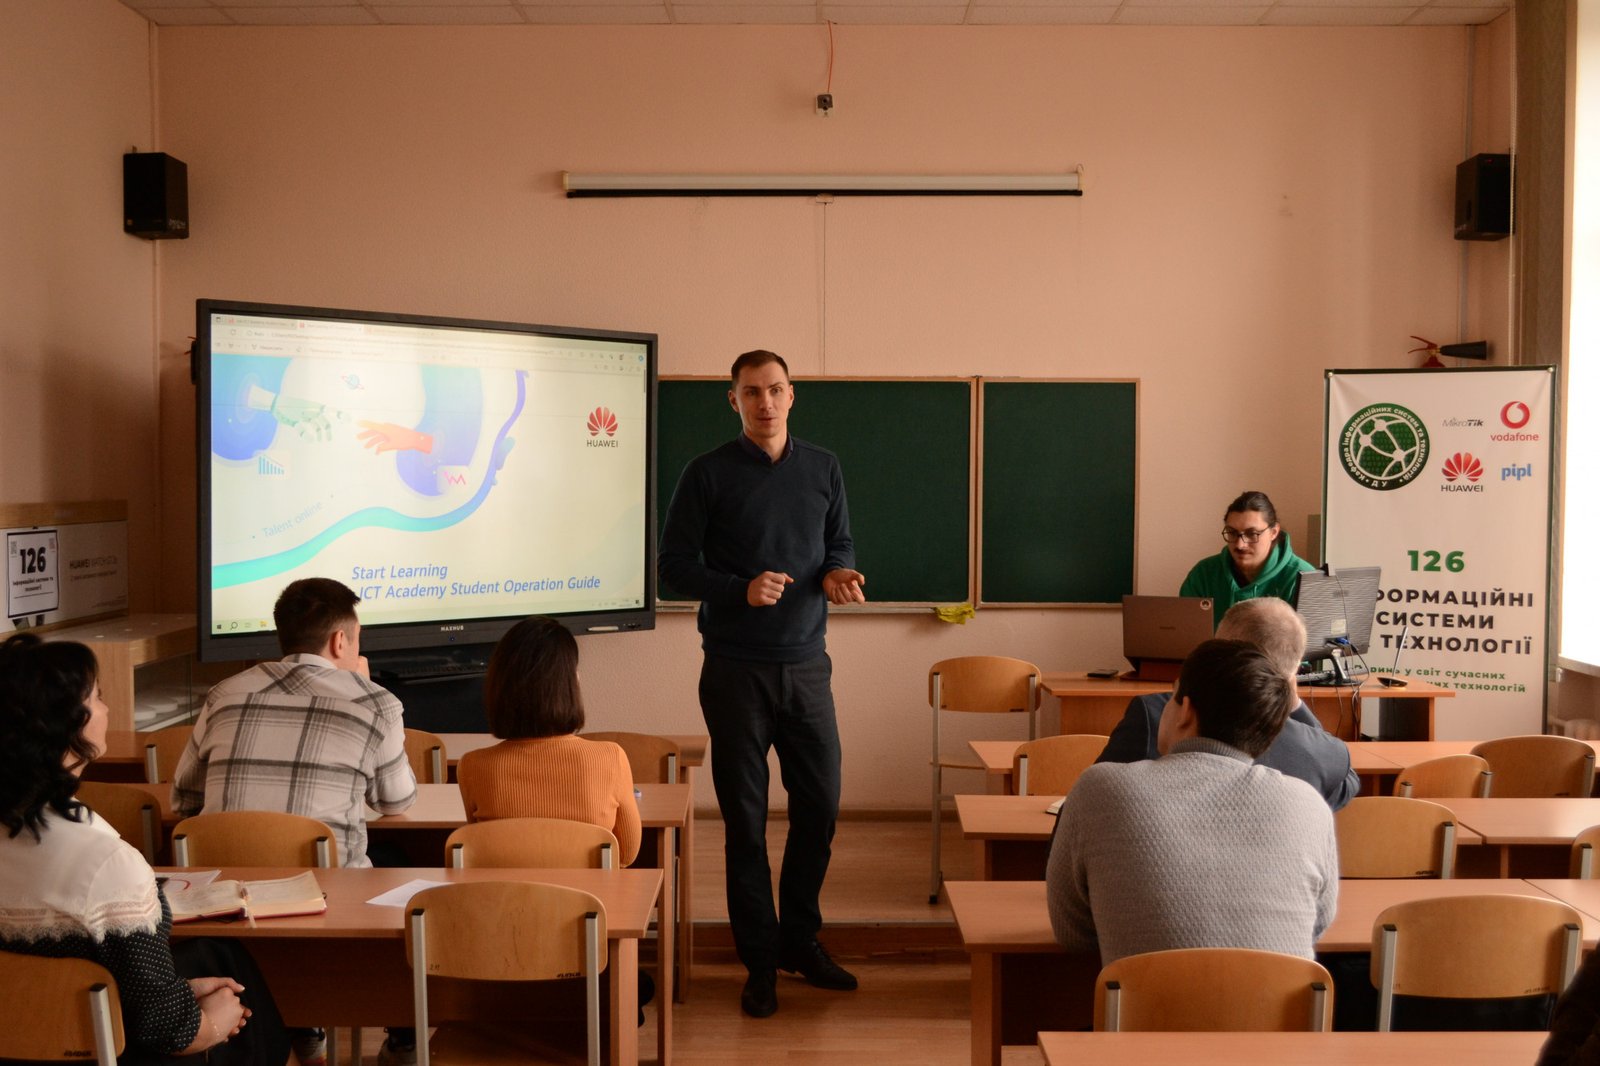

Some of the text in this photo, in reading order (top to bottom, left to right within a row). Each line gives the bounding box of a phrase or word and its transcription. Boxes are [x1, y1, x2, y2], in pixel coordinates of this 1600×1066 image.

[1394, 408, 1419, 428] систем
[1442, 417, 1484, 427] MikroTik
[586, 439, 618, 447] HUAWEI
[1490, 432, 1539, 442] vodafone
[1501, 463, 1532, 481] pipl
[1441, 484, 1483, 492] HUAWEI
[261, 501, 322, 537] Talent online
[19, 546, 46, 574] 126
[1407, 550, 1465, 573] 126
[352, 564, 448, 580] Start Learning
[385, 584, 447, 600] Academy
[450, 580, 500, 596] Student
[503, 577, 564, 595] Operation
[567, 575, 601, 590] Guide
[1376, 611, 1494, 630] СИСТЕМИ
[1380, 634, 1532, 655] ТЕХНОЛОГІЇ
[1416, 667, 1440, 676] світ
[1445, 670, 1505, 680] сучасних
[1453, 682, 1525, 692] технологій
